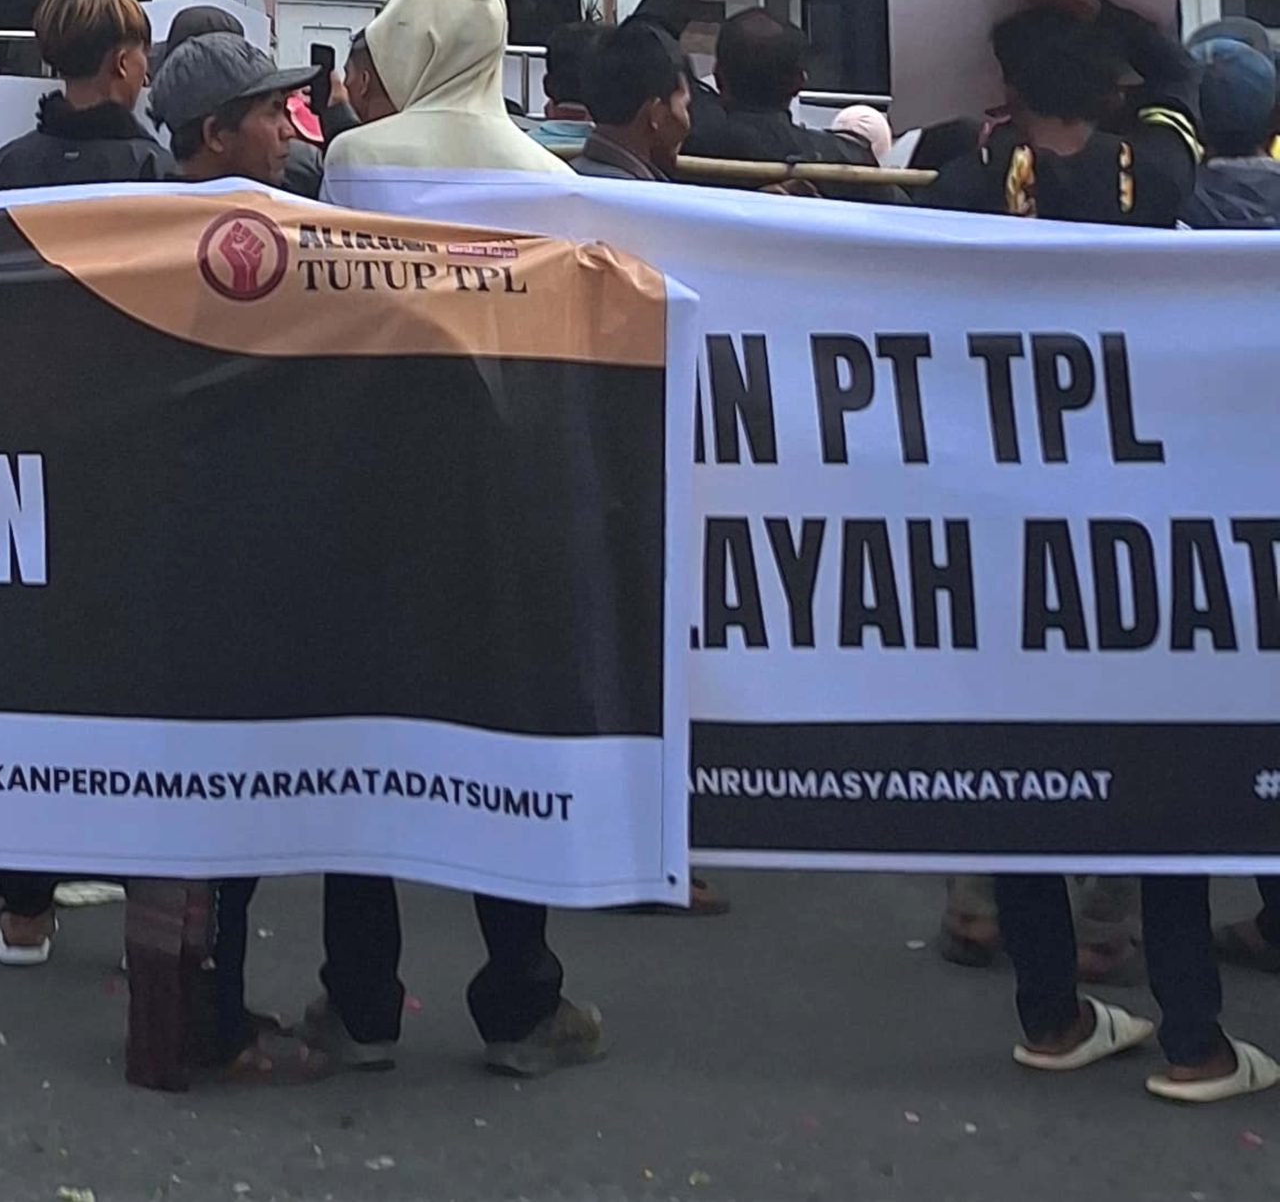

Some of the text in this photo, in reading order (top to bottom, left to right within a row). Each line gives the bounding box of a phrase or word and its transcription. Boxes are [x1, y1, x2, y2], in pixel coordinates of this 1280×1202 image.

[298, 259, 528, 294] TUTUP TPL
[810, 333, 932, 465] PT
[967, 333, 1166, 465] TPL
[690, 517, 1280, 652] AYAH ADAT
